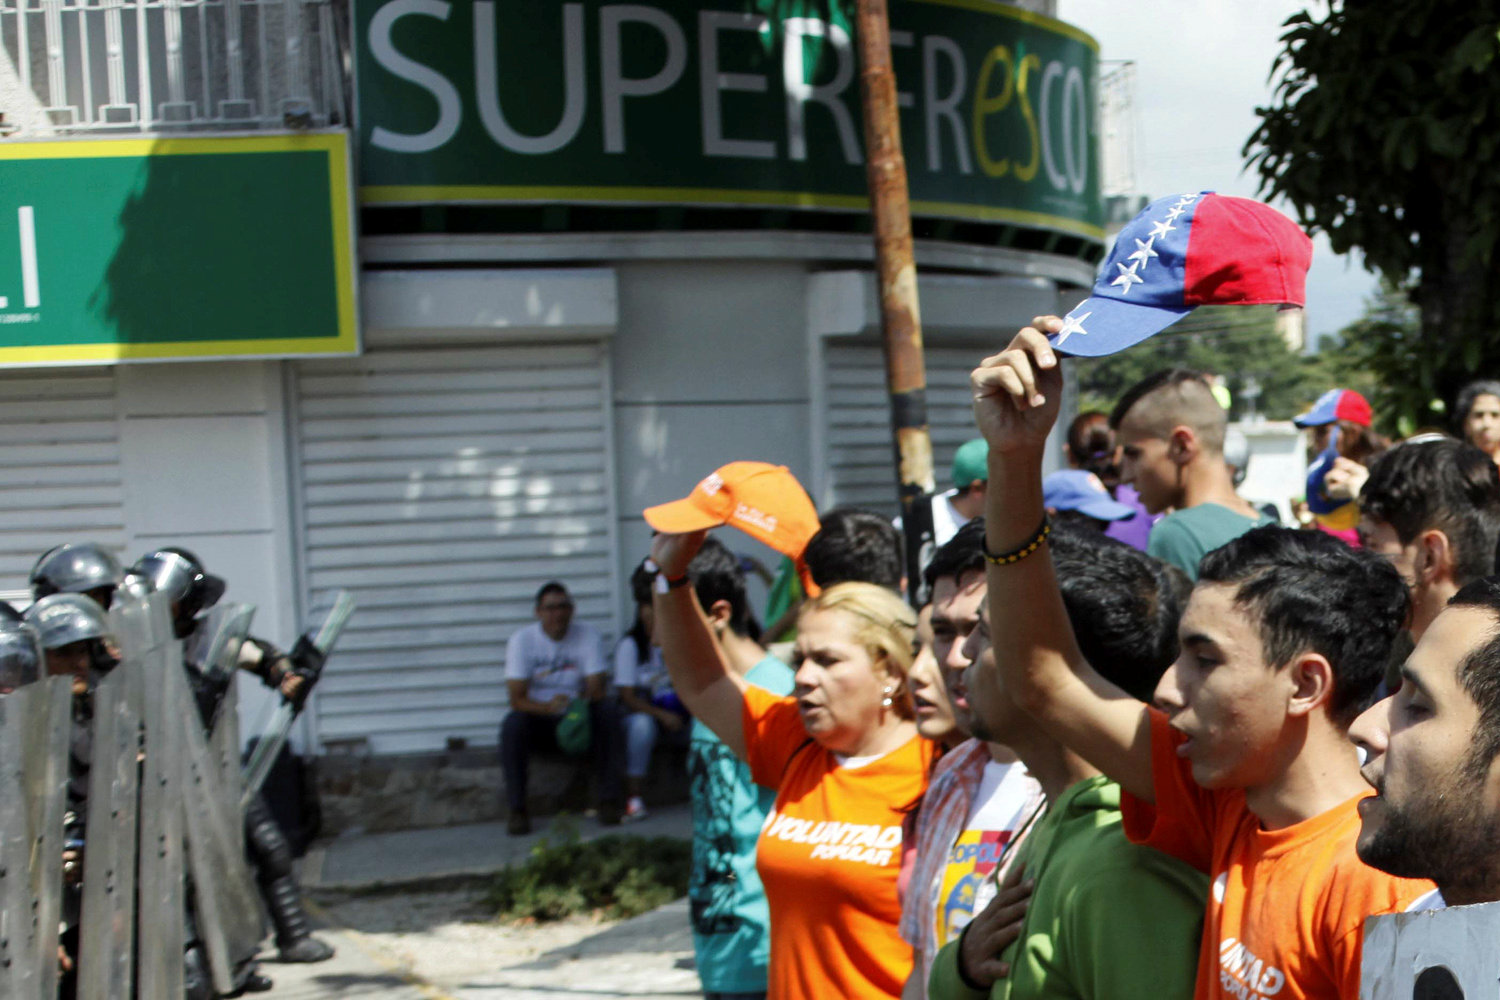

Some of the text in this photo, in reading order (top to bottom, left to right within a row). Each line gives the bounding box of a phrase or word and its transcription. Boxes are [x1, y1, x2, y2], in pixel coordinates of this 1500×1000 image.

[768, 812, 903, 849] VOLUNTAD
[810, 844, 893, 867] POPULAR
[949, 841, 1009, 864] OPOL
